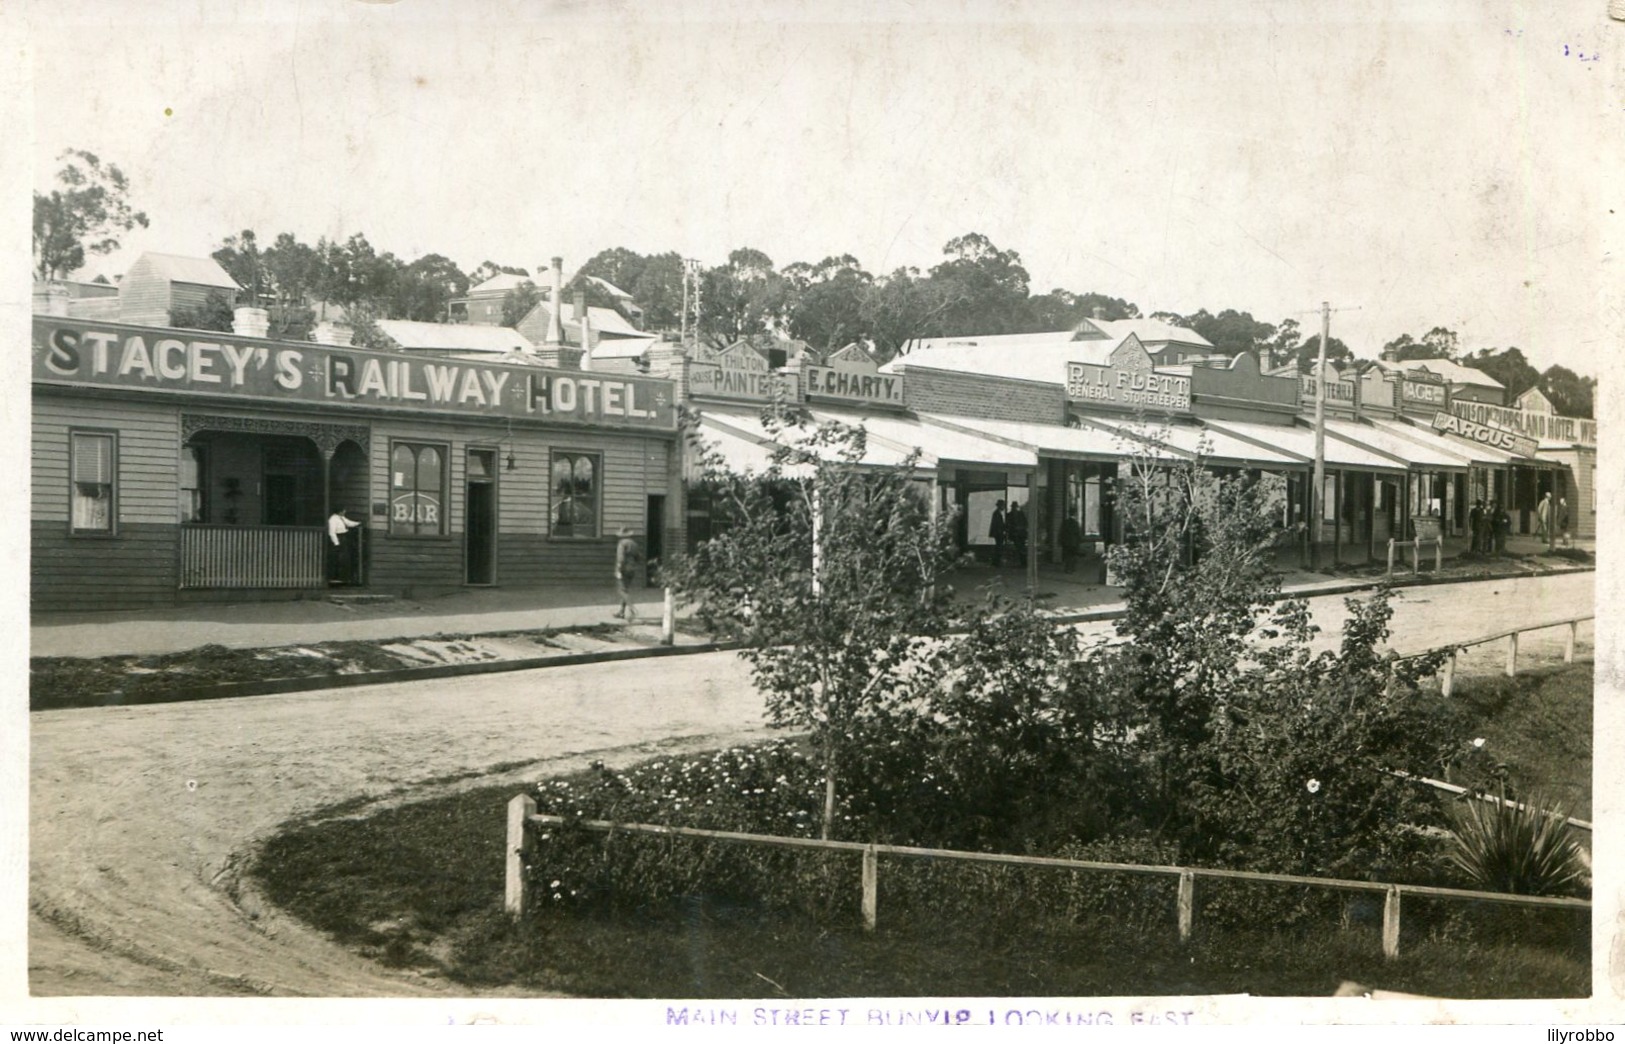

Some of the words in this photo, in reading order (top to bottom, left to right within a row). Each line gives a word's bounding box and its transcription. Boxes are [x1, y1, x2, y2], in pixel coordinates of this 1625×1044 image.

[45, 328, 303, 391] STACEY'S
[324, 354, 509, 408] RAILWAY
[1069, 364, 1090, 386] R.
[1068, 386, 1116, 401] GENERAL
[1442, 416, 1516, 451] ARGUS
[394, 503, 438, 524] BAR
[666, 1007, 737, 1025] MAIN
[753, 1007, 850, 1025] STREET
